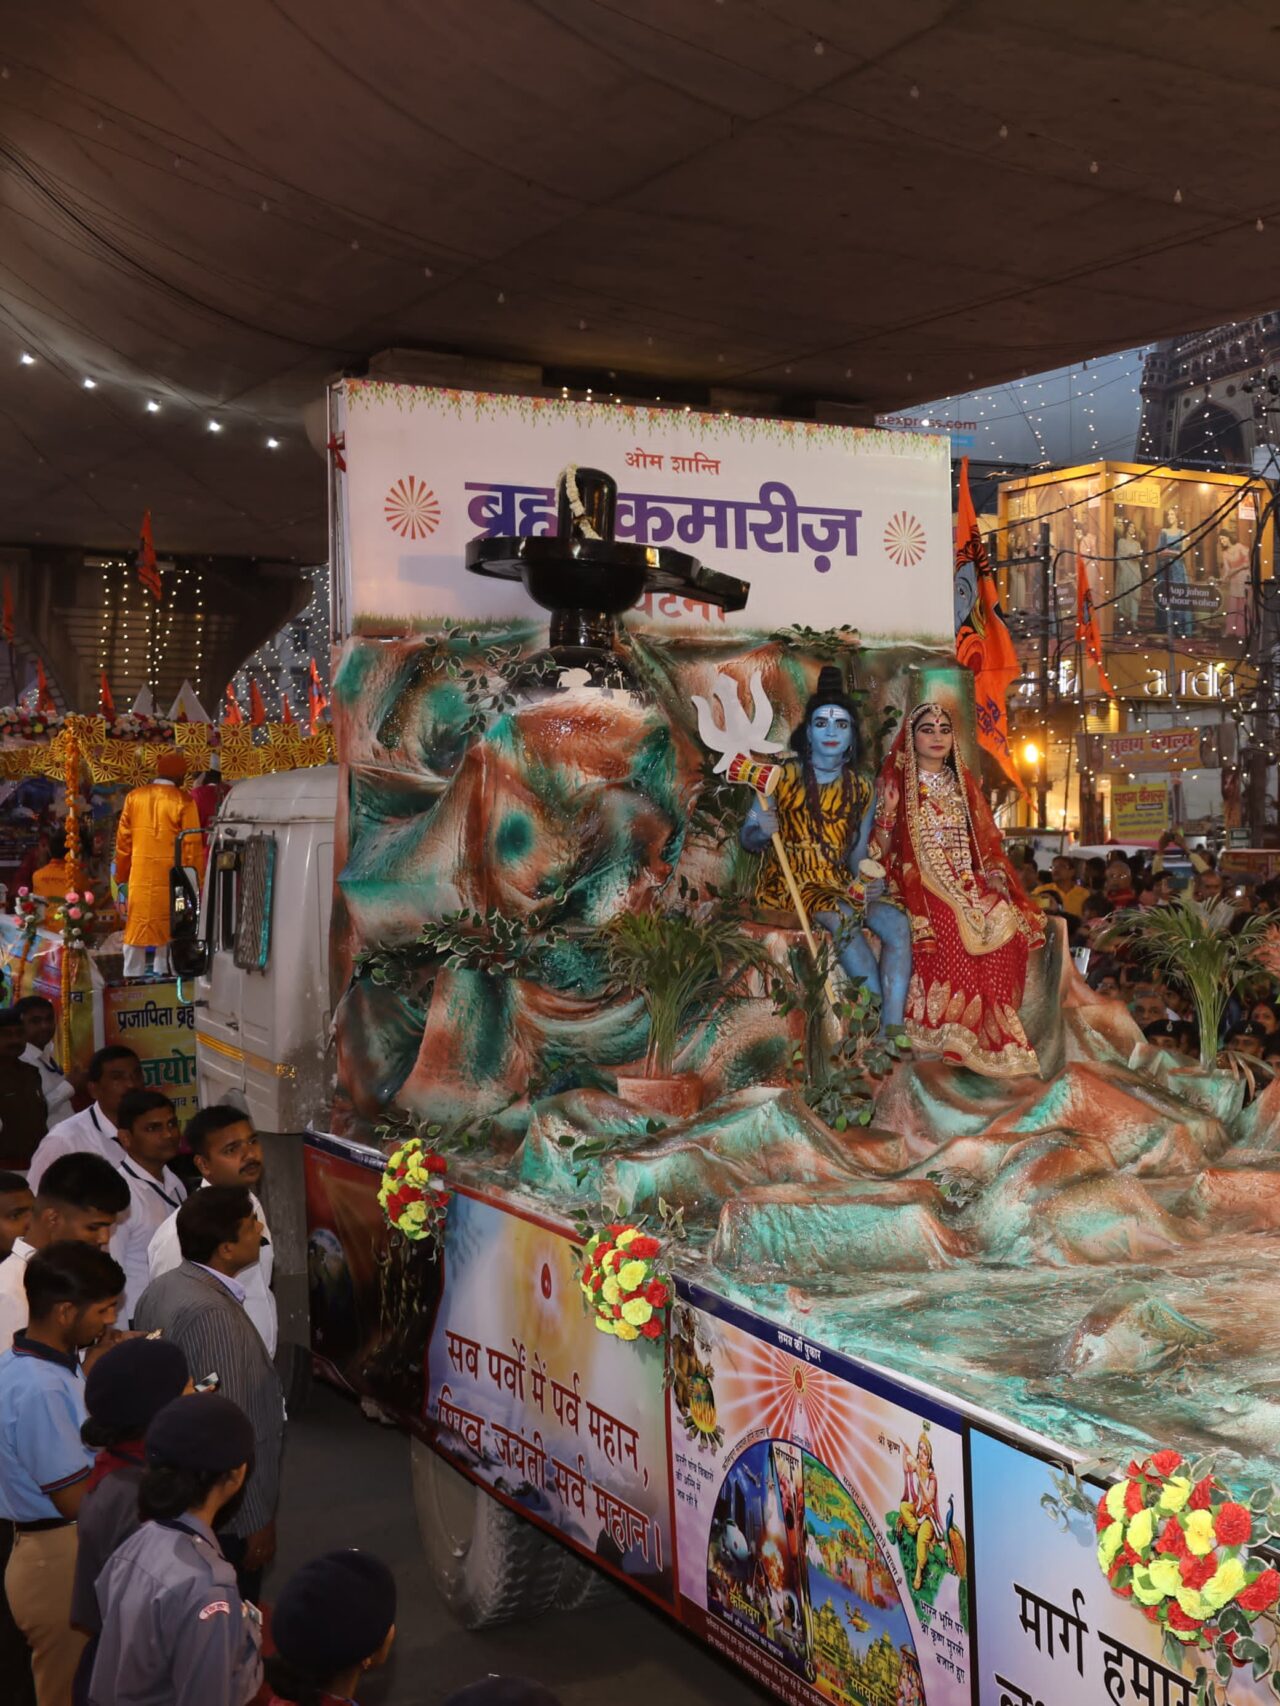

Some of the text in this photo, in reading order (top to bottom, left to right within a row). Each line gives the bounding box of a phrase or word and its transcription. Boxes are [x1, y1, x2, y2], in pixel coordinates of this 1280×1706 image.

[625, 447, 722, 475] ओम शान्ति
[117, 1001, 173, 1032] प्रजापिता
[485, 1337, 526, 1401] पर्वों
[530, 1352, 546, 1414] में
[550, 1372, 582, 1435] पर्व
[437, 1384, 486, 1457] शिव
[491, 1425, 547, 1489] जयंती
[551, 1455, 588, 1517] सर्व
[1013, 1582, 1089, 1679] मार्ग
